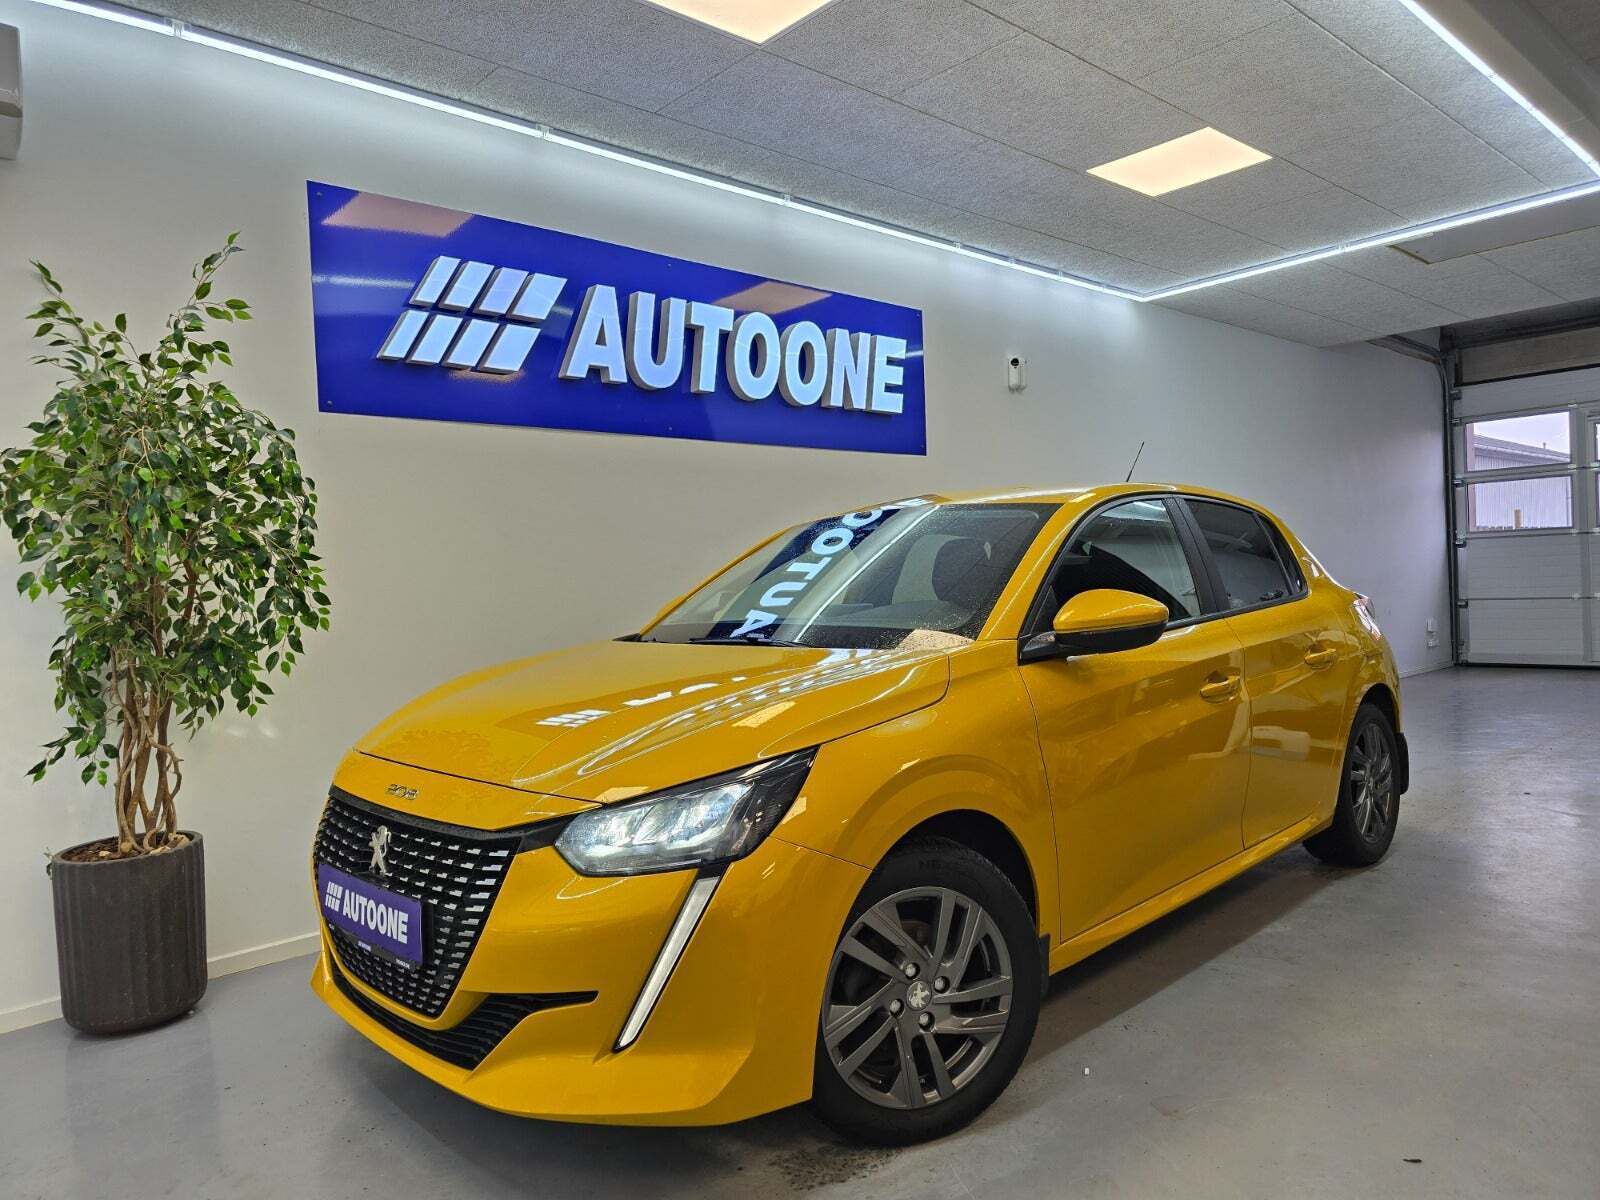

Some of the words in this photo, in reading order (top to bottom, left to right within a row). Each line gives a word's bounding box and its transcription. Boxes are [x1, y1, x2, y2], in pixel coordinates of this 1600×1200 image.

[559, 284, 907, 414] AUTOONE
[388, 783, 418, 801] 208
[342, 888, 409, 944] AUTOONE
